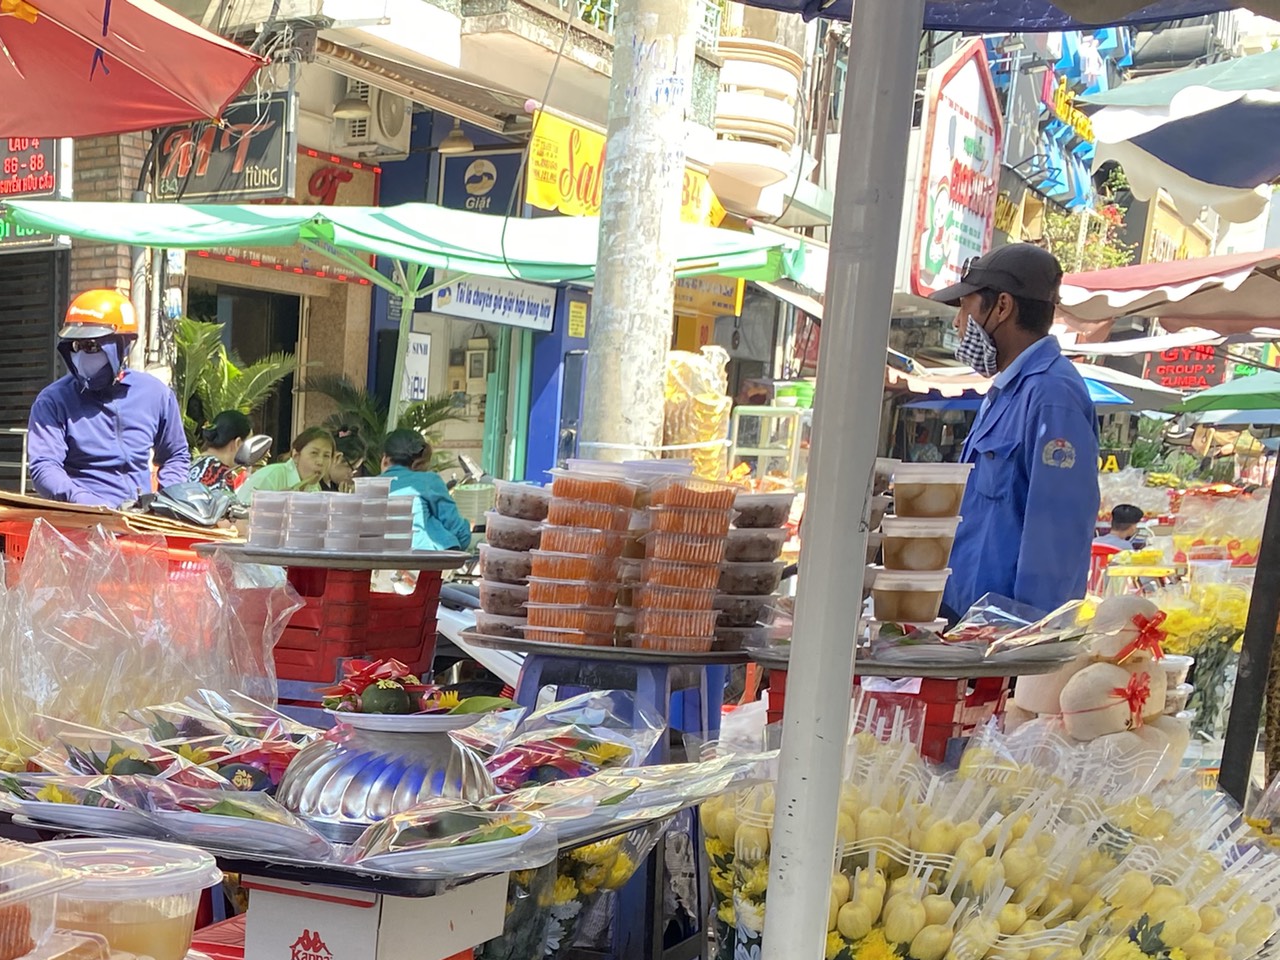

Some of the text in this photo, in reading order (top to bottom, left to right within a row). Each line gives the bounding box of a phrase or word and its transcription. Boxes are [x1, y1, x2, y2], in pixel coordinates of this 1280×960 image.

[4, 157, 18, 173] 86
[30, 154, 44, 171] 88
[558, 127, 608, 207] Sal
[245, 165, 278, 187] HÙNG
[465, 197, 491, 211] Giặt
[1160, 345, 1215, 362] GYM
[1156, 364, 1216, 375] GROUP X
[1161, 376, 1207, 387] ZUMBA
